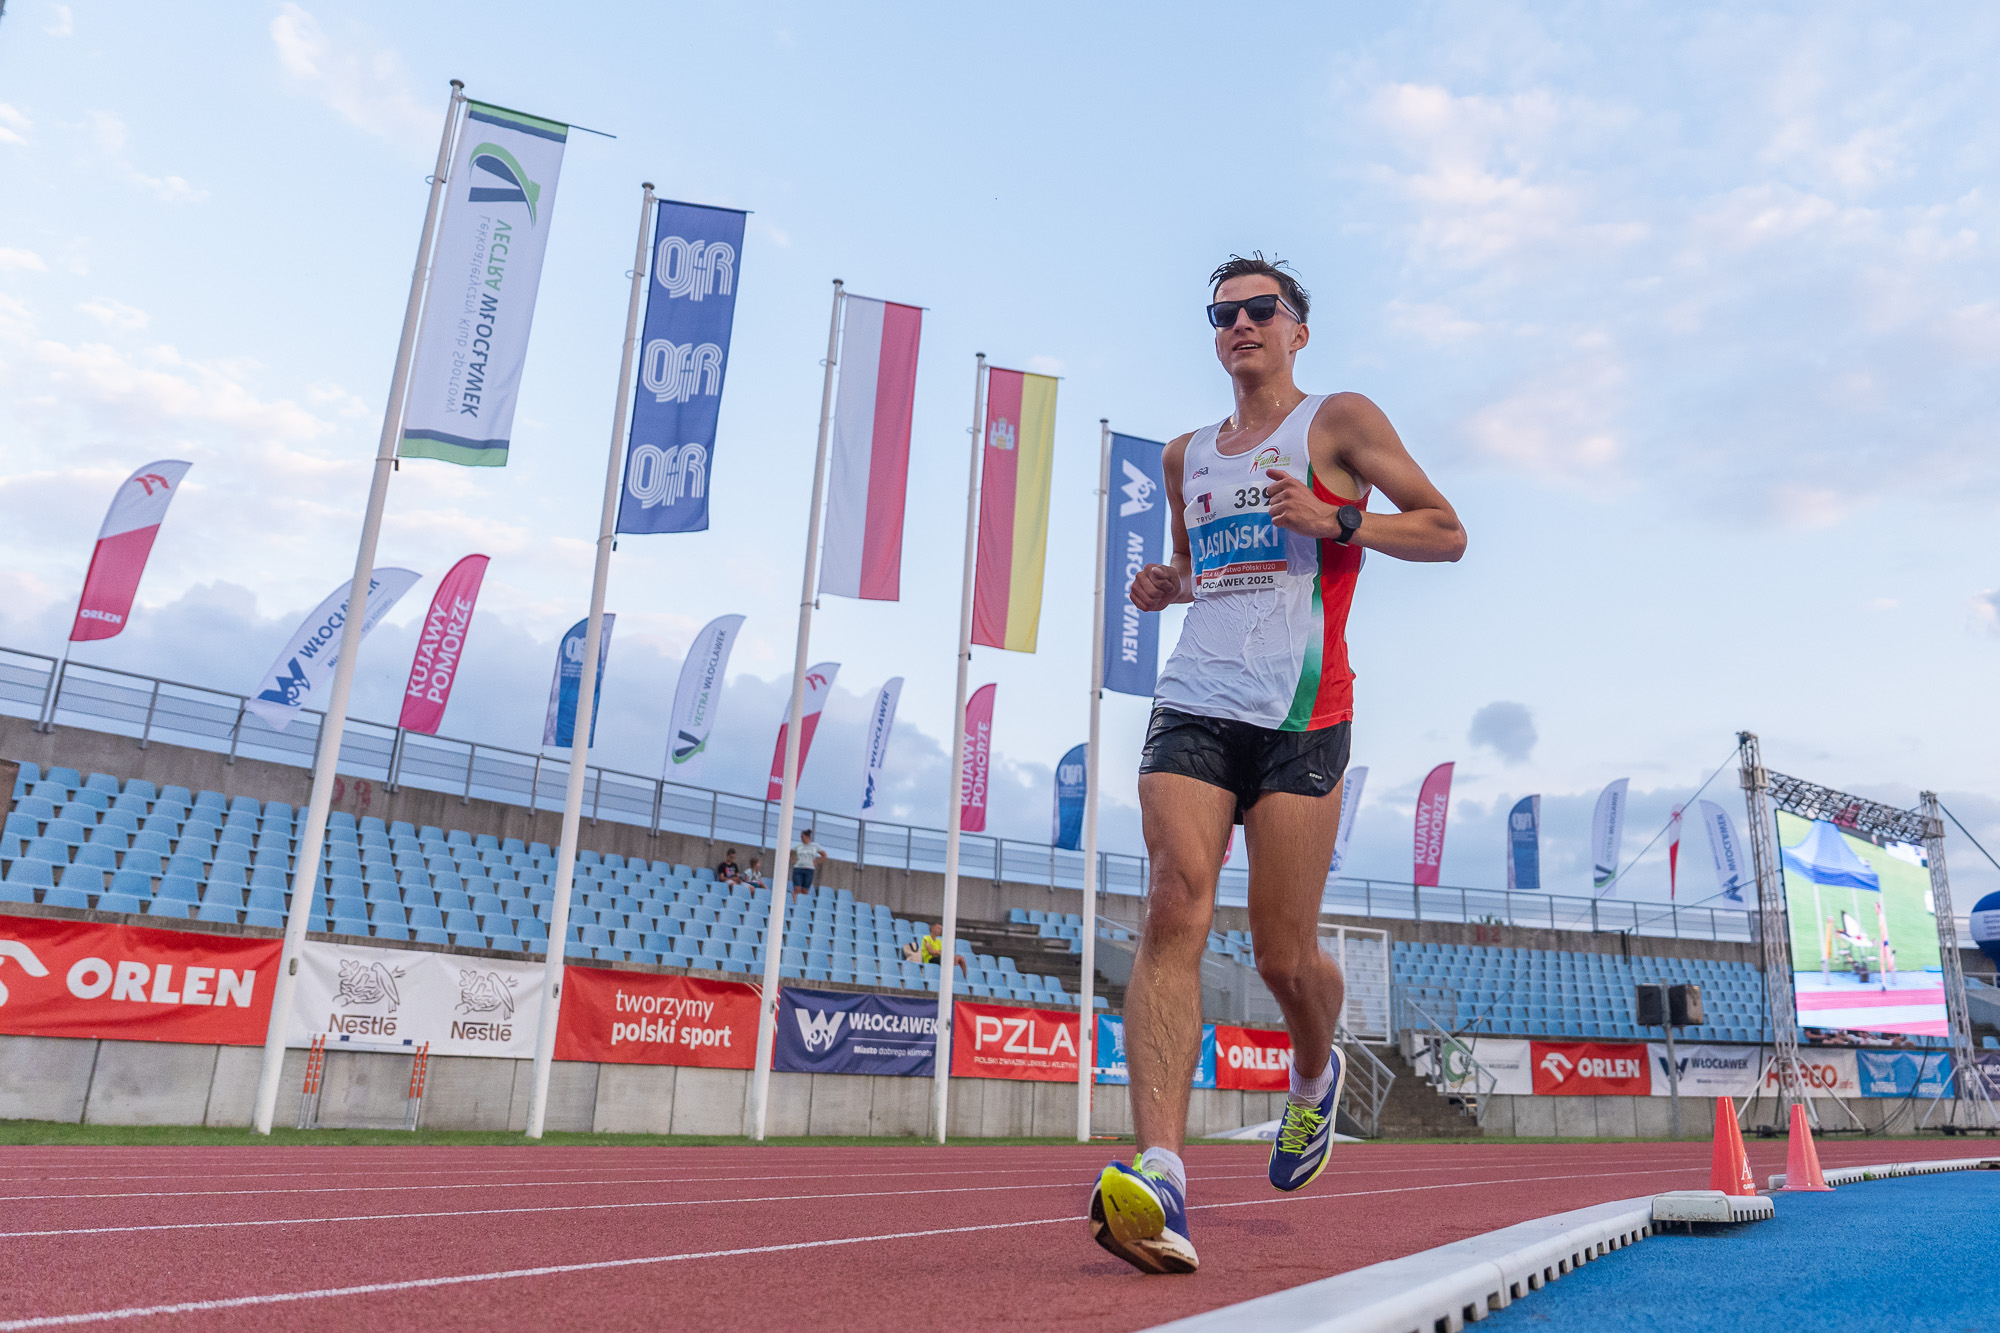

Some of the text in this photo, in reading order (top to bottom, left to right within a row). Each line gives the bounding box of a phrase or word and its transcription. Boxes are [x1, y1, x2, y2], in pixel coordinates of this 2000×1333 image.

[1198, 522, 1279, 562] JASIŃSKI
[1242, 563, 1262, 571] Polski
[1247, 575, 1274, 585] 2025
[80, 608, 122, 624] ORLEN
[407, 602, 447, 698] KUJAWY
[427, 595, 472, 704] POMORZE
[972, 721, 989, 808] POMORZE
[1414, 801, 1432, 865] KUJAWY
[1426, 793, 1447, 866] POMORZE
[66, 956, 256, 1008] ORLEN
[615, 988, 714, 1023] tworzymy
[329, 1013, 397, 1036] Nestlé
[450, 1020, 512, 1043] Nestlé
[611, 1017, 731, 1050] polski sport
[849, 1012, 939, 1035] WŁOCŁAWEK
[975, 1015, 1077, 1057] PZLA
[1228, 1045, 1294, 1071] ORLEN
[1578, 1057, 1640, 1079] ORLEN
[1691, 1057, 1749, 1069] WŁOCŁAWEK
